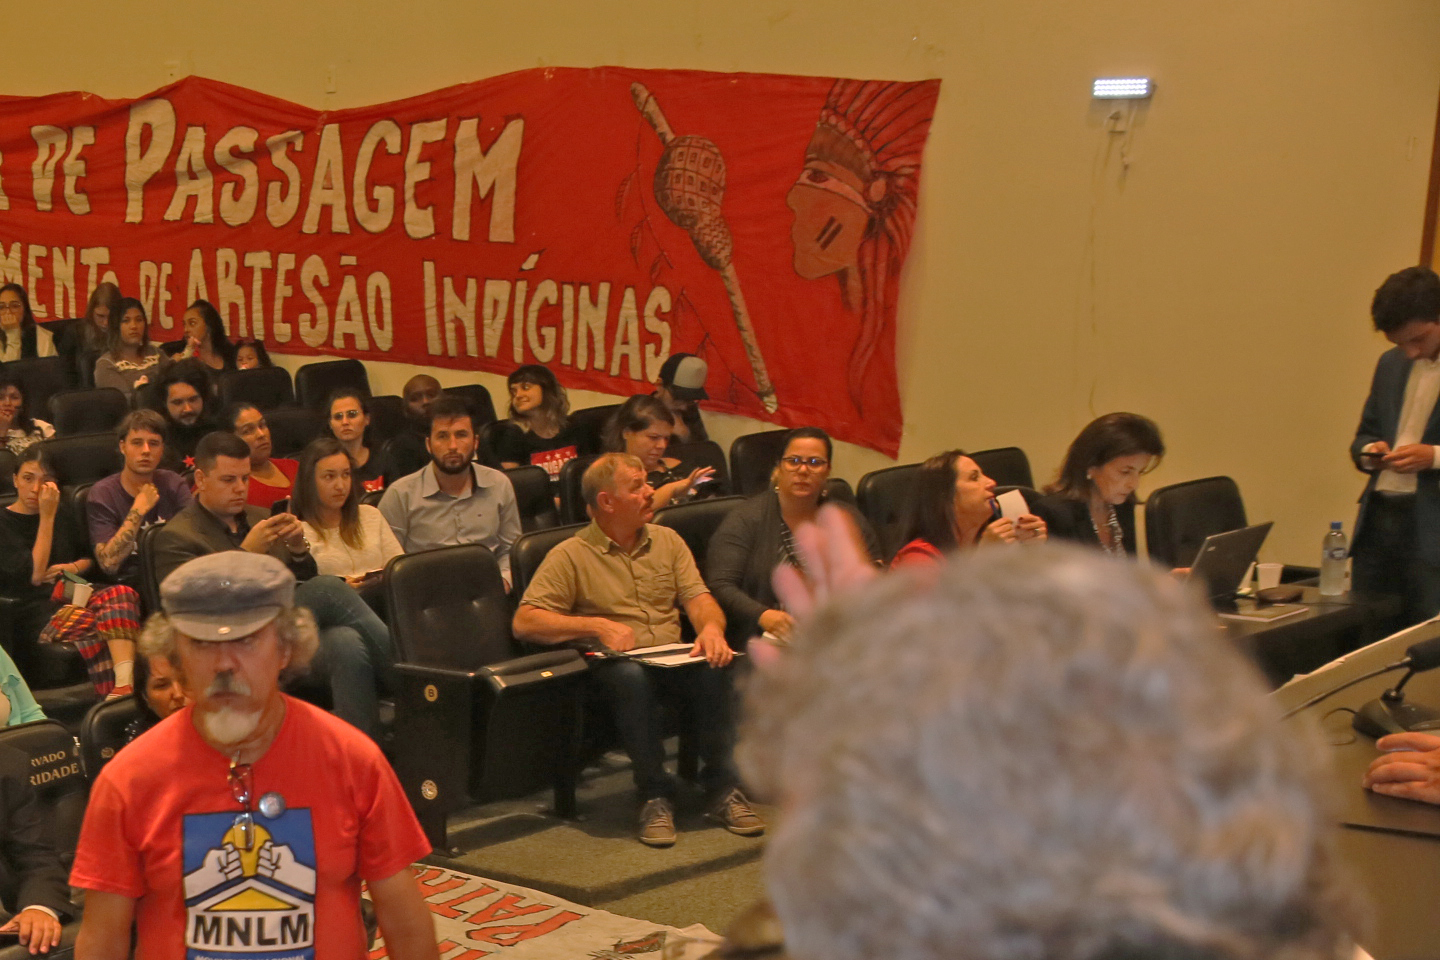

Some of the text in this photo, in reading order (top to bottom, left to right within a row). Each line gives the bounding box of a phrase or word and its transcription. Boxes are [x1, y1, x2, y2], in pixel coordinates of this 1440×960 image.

[30, 124, 96, 216] DE
[123, 98, 526, 243] PASSAGEM
[139, 260, 174, 330] DE
[186, 247, 394, 352] ARTESÃO
[422, 249, 673, 384] INDÍGINAS
[192, 913, 309, 946] MNLM
